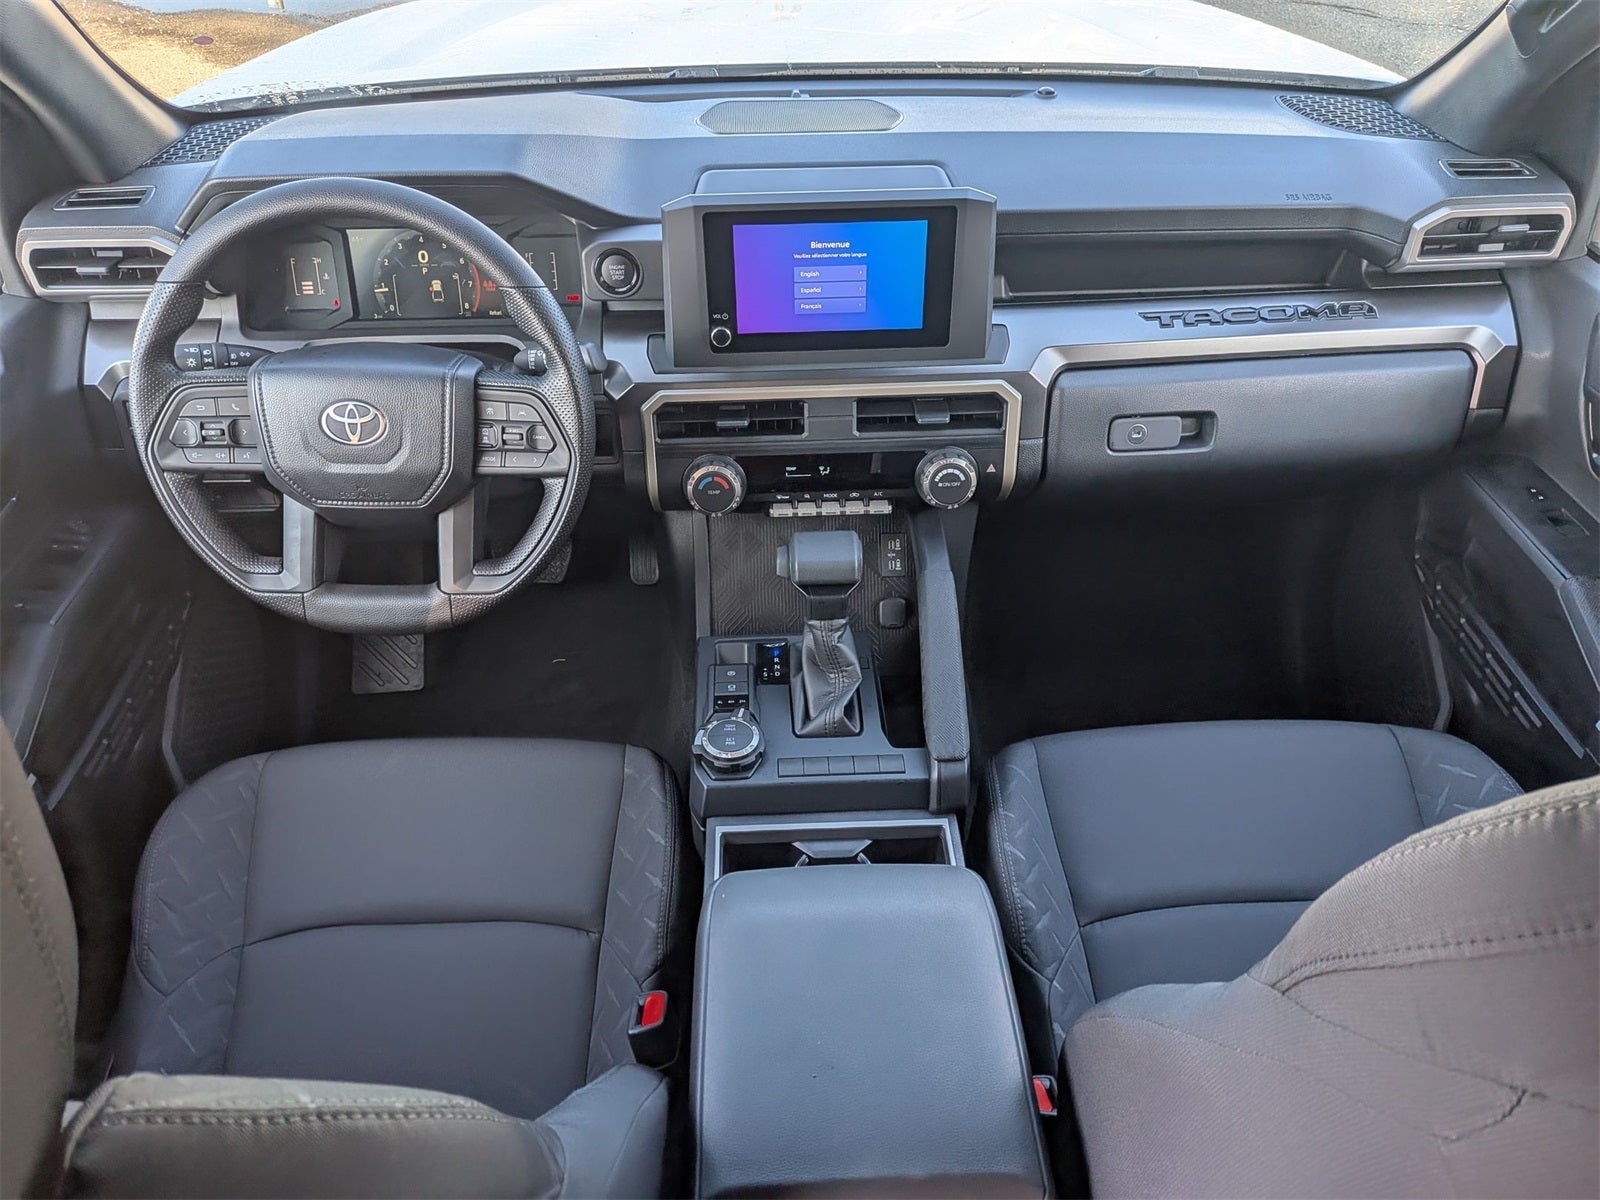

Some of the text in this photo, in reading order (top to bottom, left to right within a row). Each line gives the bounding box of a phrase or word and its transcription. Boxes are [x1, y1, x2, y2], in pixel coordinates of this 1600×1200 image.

[1301, 193, 1332, 201] AIRBAG
[810, 241, 850, 249] Bienvenue
[417, 250, 429, 263] 0
[800, 271, 820, 279] English
[1136, 301, 1379, 329] TACOMA
